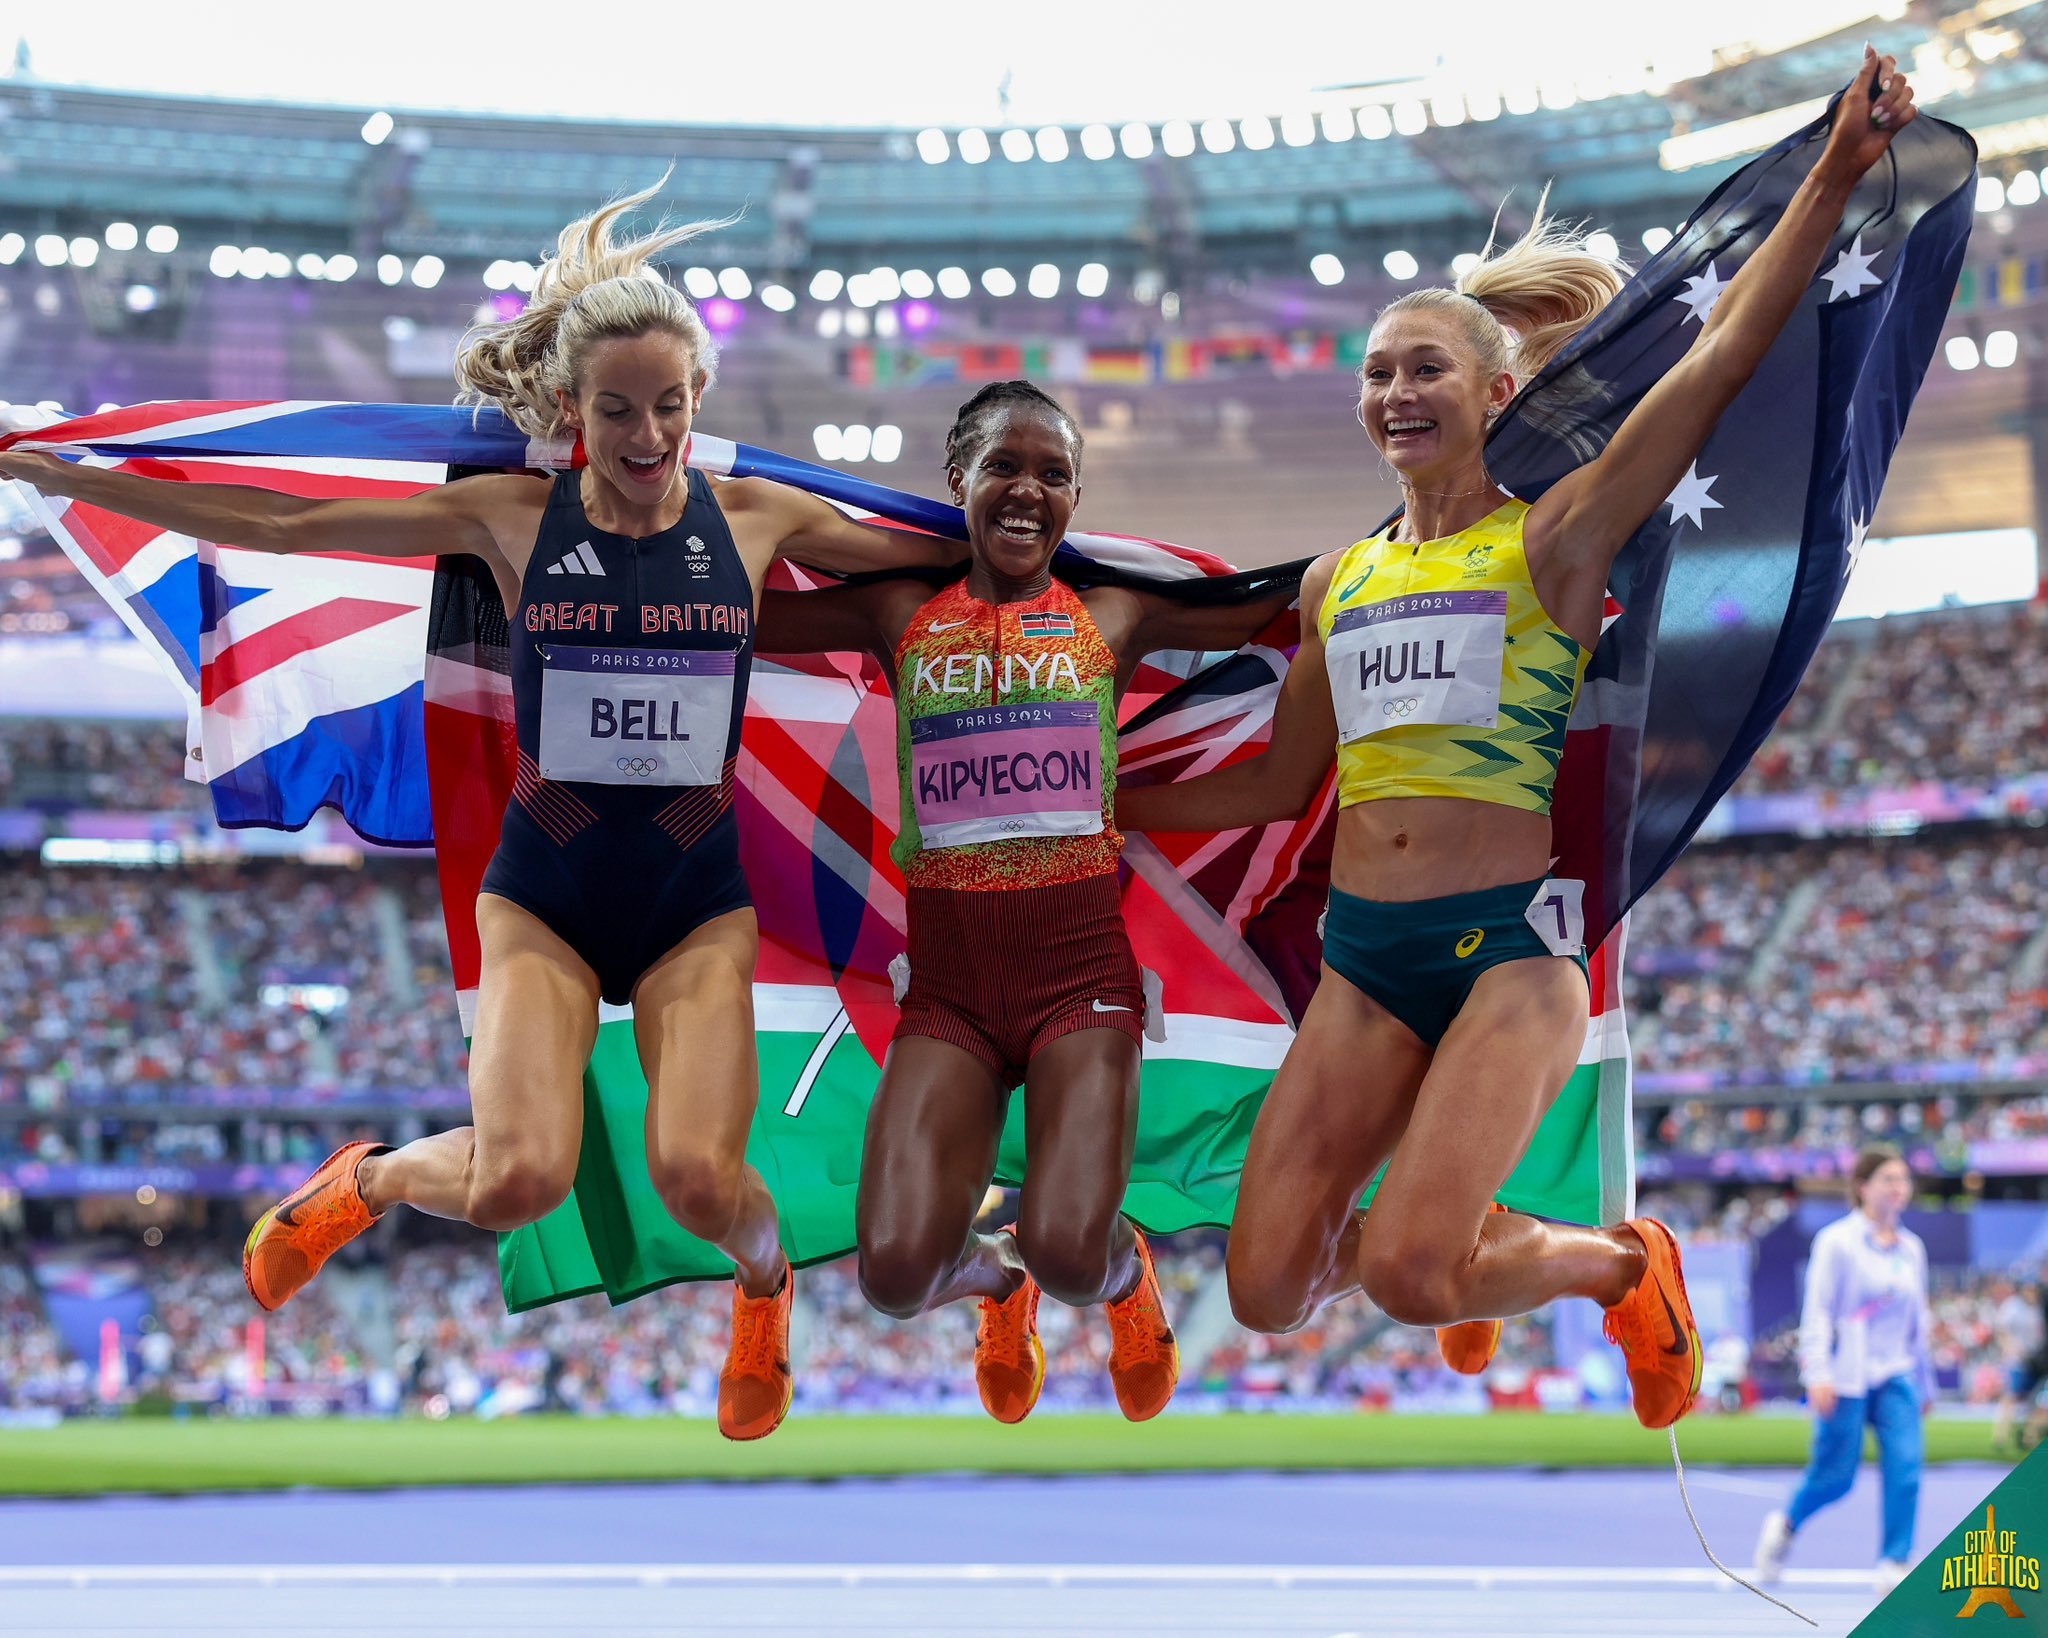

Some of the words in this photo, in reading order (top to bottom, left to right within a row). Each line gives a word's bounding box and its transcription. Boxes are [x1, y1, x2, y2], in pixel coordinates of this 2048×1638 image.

[525, 602, 619, 632] GREAT
[641, 604, 748, 636] BRITAIN
[1411, 597, 1452, 611] 2024
[646, 656, 690, 669] 2024
[913, 653, 1081, 696] KENYA
[1359, 640, 1456, 691] HULL
[590, 697, 690, 741] BELL
[1009, 711, 1052, 723] 2024
[919, 750, 1091, 805] KIPYEGON
